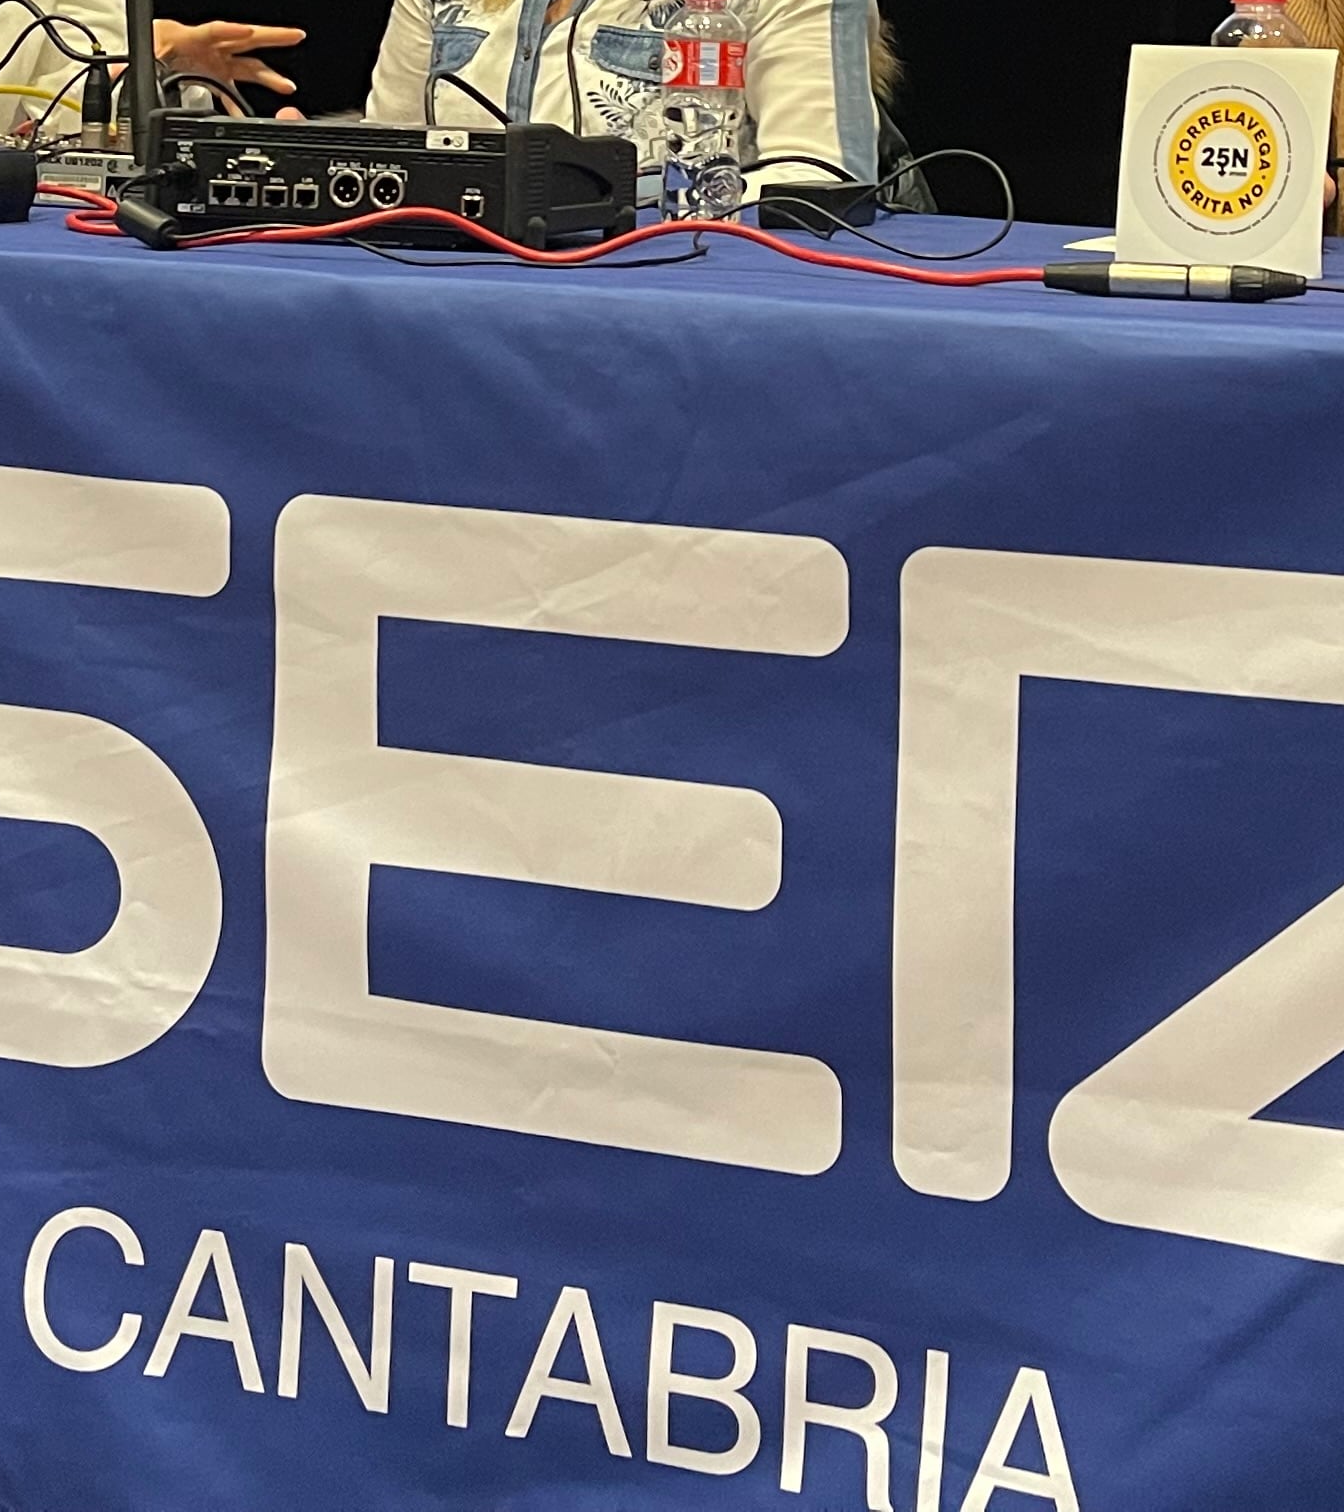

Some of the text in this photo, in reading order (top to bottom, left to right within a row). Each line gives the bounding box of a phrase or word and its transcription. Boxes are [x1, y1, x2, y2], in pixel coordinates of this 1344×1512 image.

[1176, 109, 1271, 171] TORRELAVEGA
[1201, 147, 1248, 174] 25N
[1181, 180, 1264, 214] GRITA NO
[24, 1205, 1081, 1512] CANTABRIA
